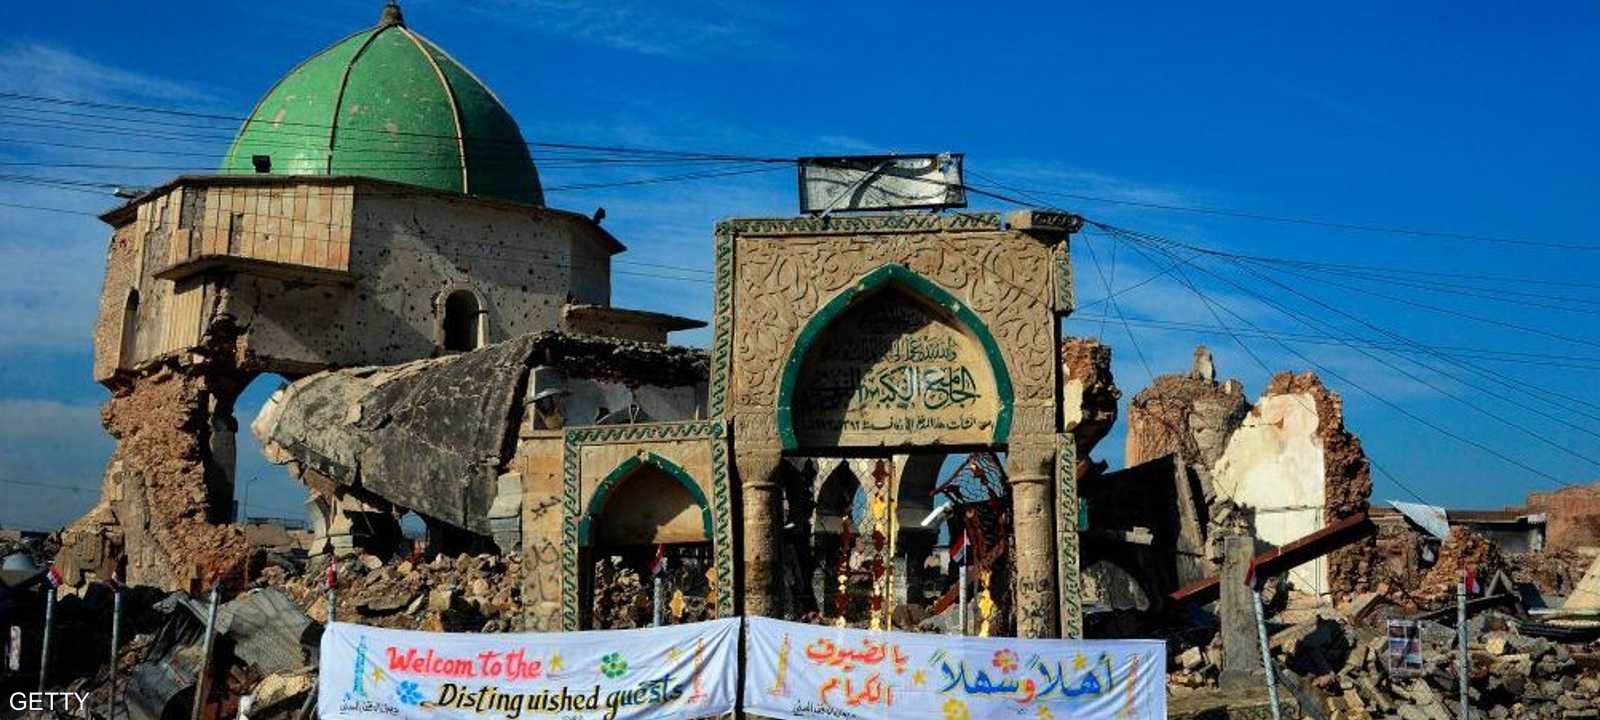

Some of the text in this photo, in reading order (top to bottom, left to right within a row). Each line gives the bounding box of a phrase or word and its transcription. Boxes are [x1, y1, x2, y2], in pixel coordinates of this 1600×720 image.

[863, 366, 918, 410] الكبير
[919, 366, 981, 410] الجامع
[386, 646, 543, 681] Welcom to the
[806, 639, 908, 675] بالضيوف
[420, 673, 684, 720] Distinguished guests
[819, 673, 892, 708] الكرام
